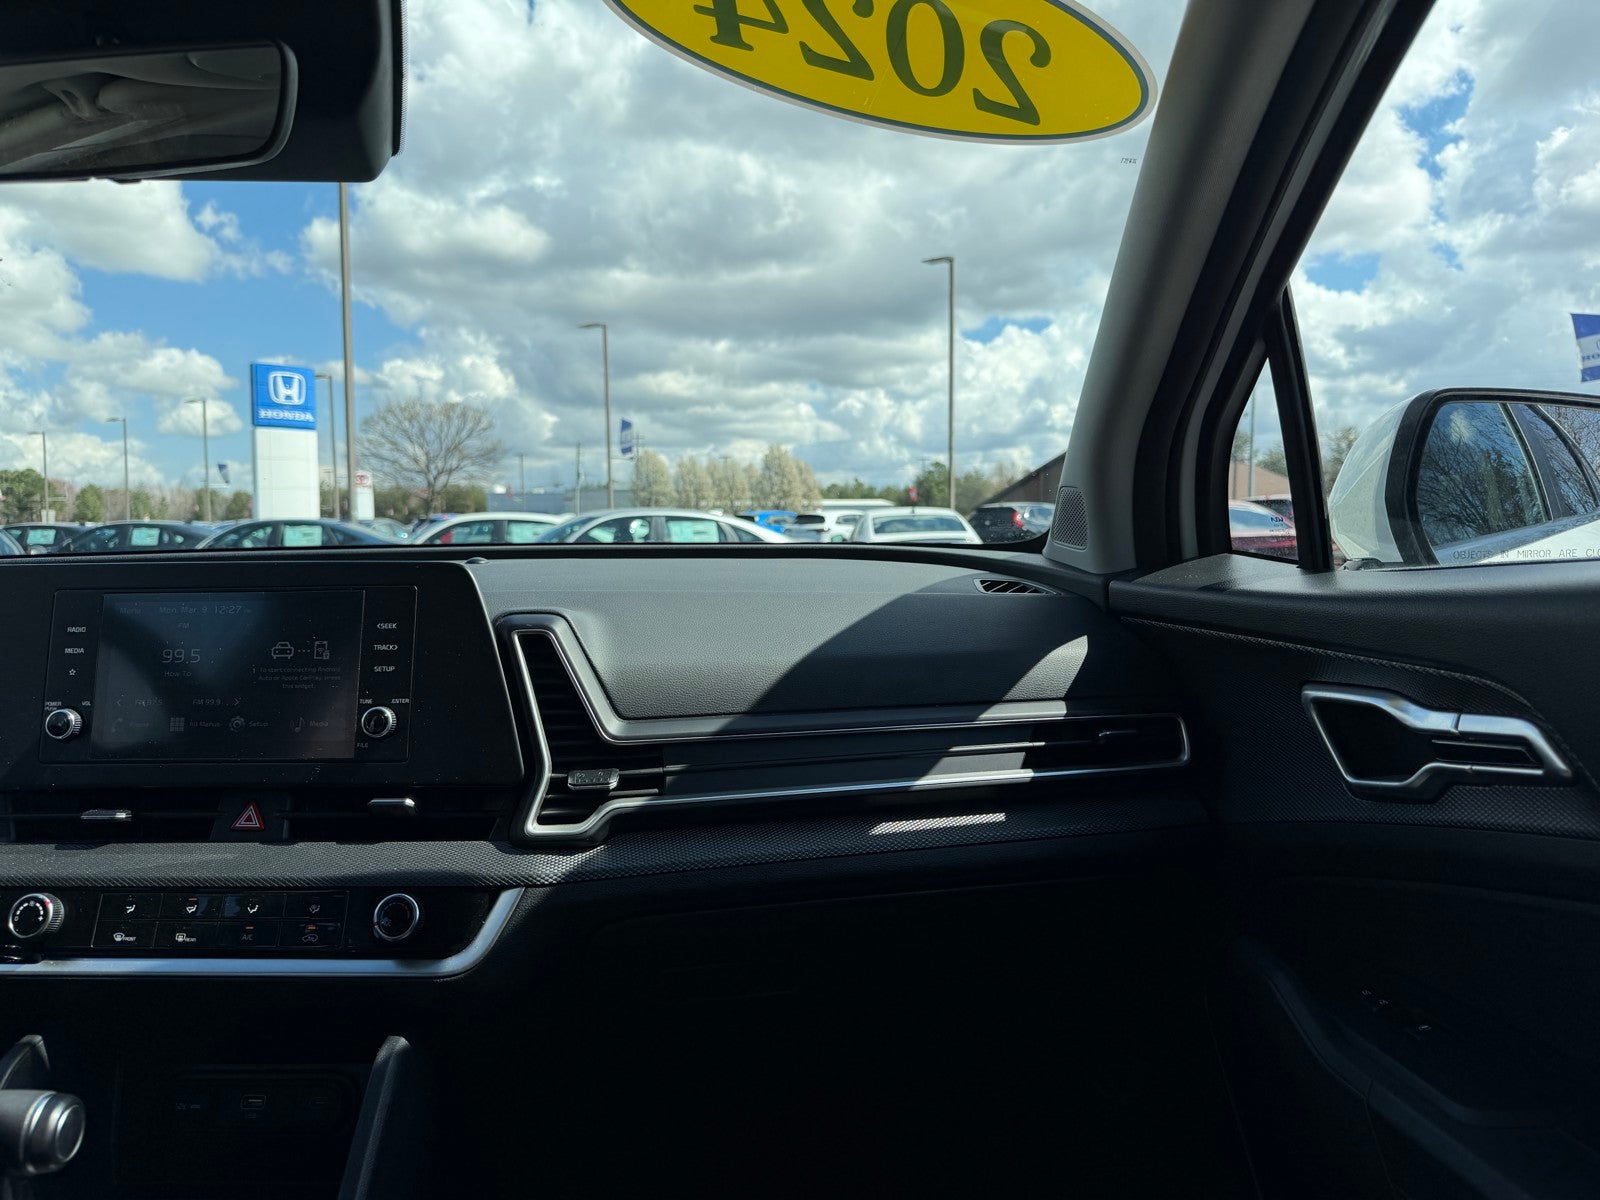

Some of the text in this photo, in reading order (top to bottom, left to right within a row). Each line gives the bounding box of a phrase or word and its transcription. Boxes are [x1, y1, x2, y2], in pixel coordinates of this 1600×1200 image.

[258, 408, 314, 422] HONDA
[1453, 550, 1494, 560] OBJECTS
[1500, 550, 1509, 559] IN
[1517, 549, 1552, 559] MIRROR
[1560, 548, 1578, 558] ARE
[159, 606, 177, 615] Mon
[214, 604, 243, 616] 12:27
[66, 625, 88, 633] RADIO
[379, 622, 397, 630] SEEK
[64, 647, 85, 655] MEDIA
[161, 648, 202, 665] 99.5
[373, 665, 396, 673] SETUP
[164, 670, 192, 678] How To
